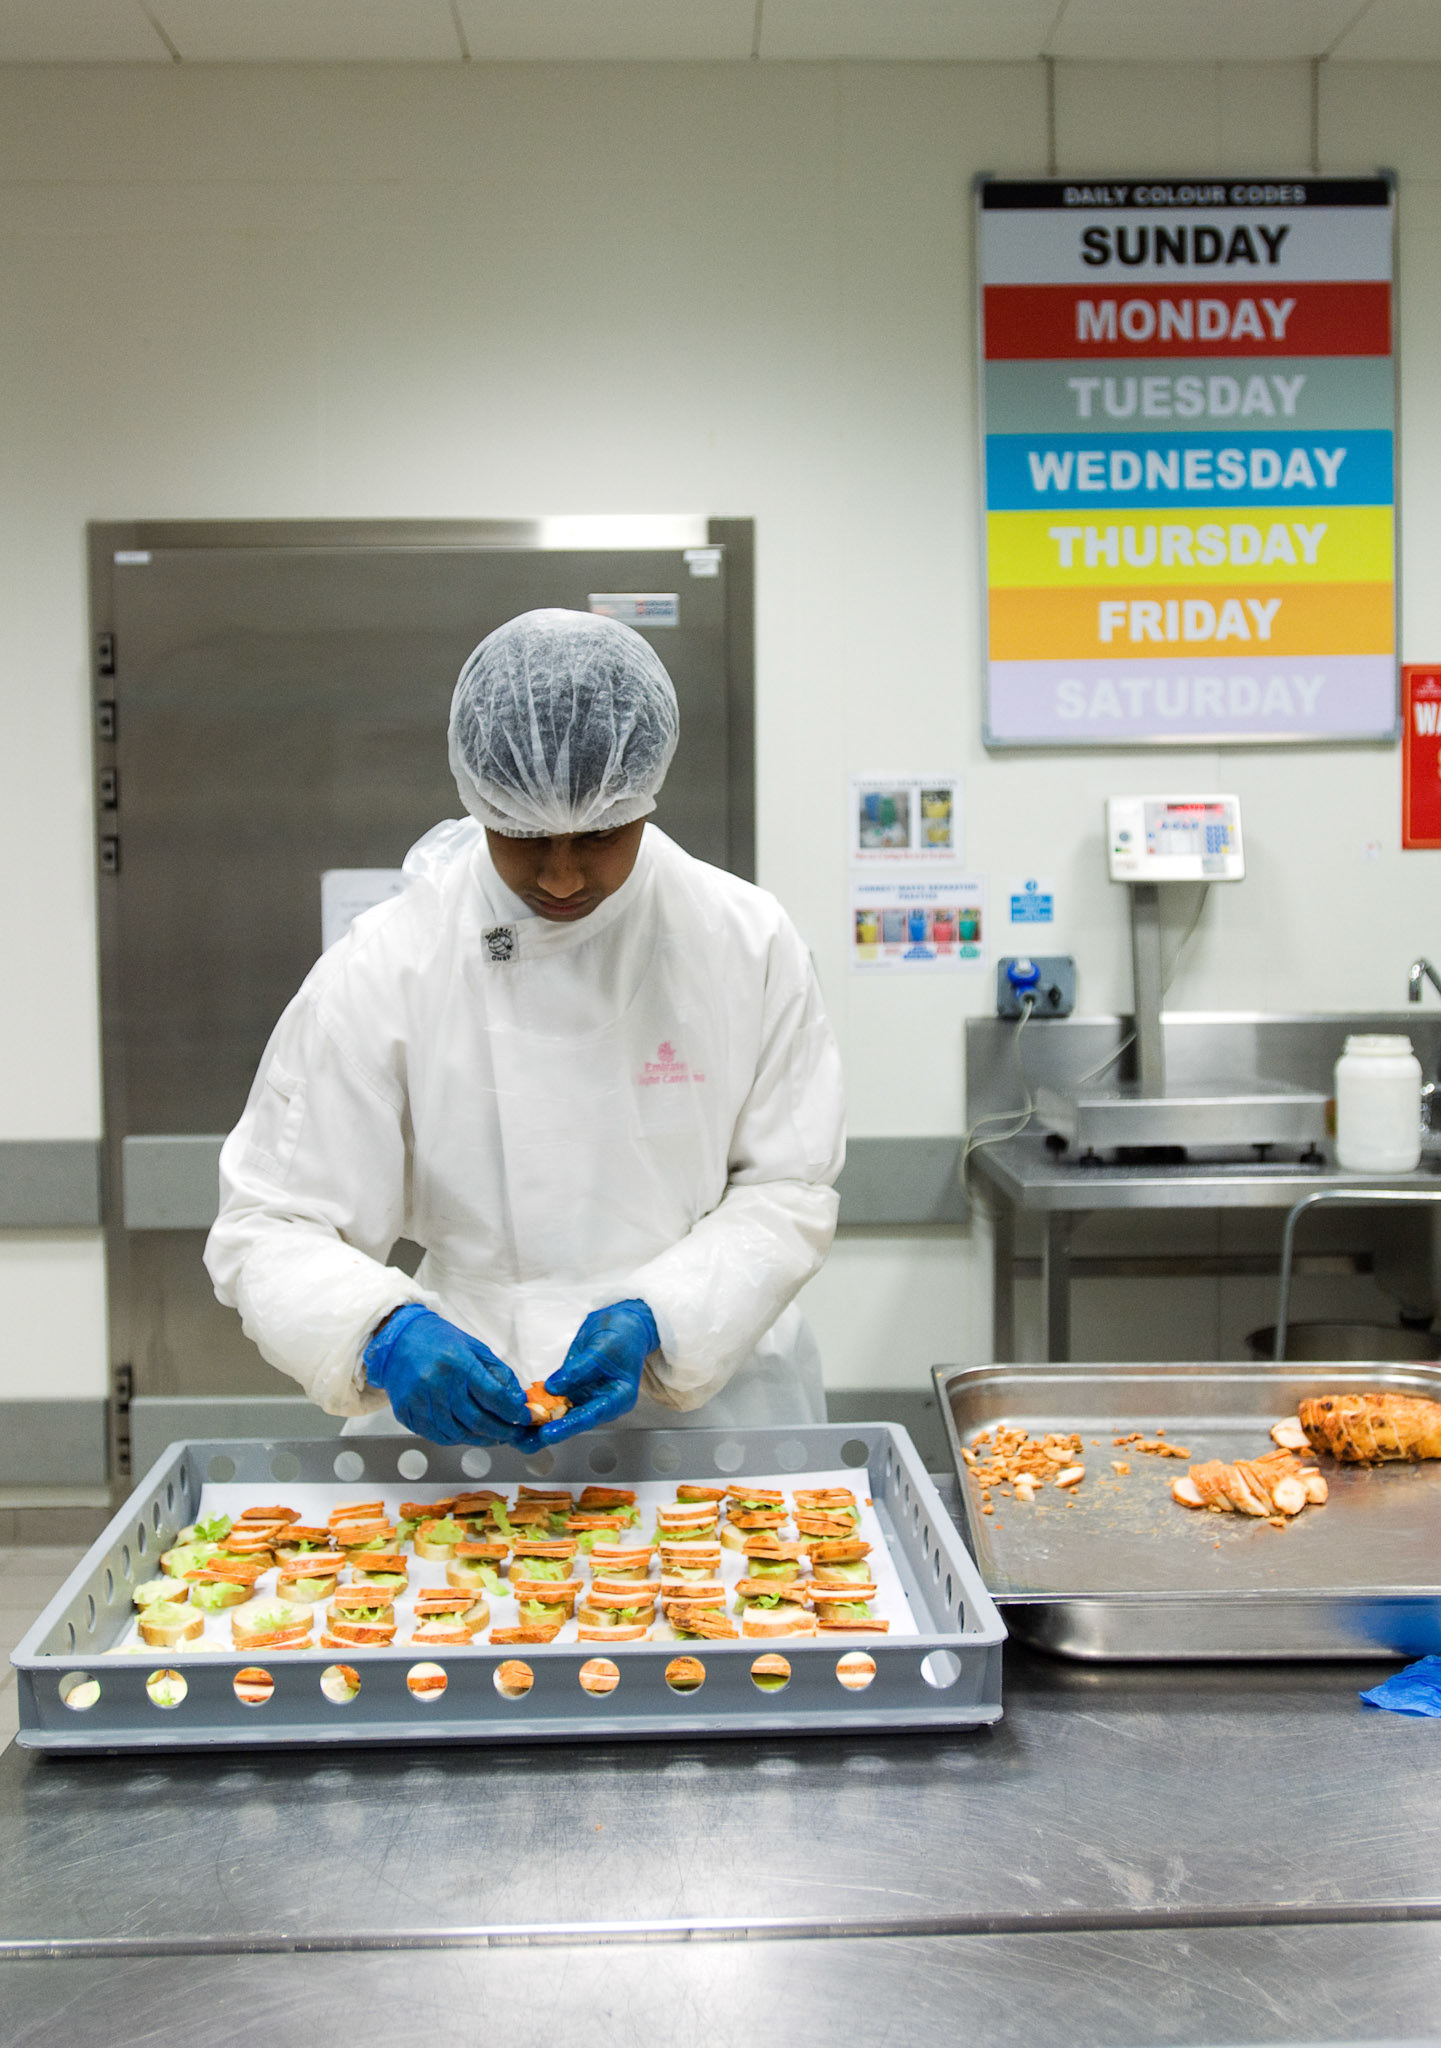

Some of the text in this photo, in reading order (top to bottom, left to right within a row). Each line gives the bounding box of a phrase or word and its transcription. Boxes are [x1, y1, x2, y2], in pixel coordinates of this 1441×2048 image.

[1063, 185, 1307, 205] DAILY COLOUR CODES
[1082, 224, 1290, 265] SUNDAY
[1075, 299, 1297, 341] MONDAY
[1067, 375, 1307, 417] TUESDAY
[1028, 448, 1347, 491] WEDNESDAY
[1048, 523, 1328, 567] THURSDAY
[1097, 599, 1282, 642] FRIDAY
[1055, 674, 1327, 719] SATURDAY
